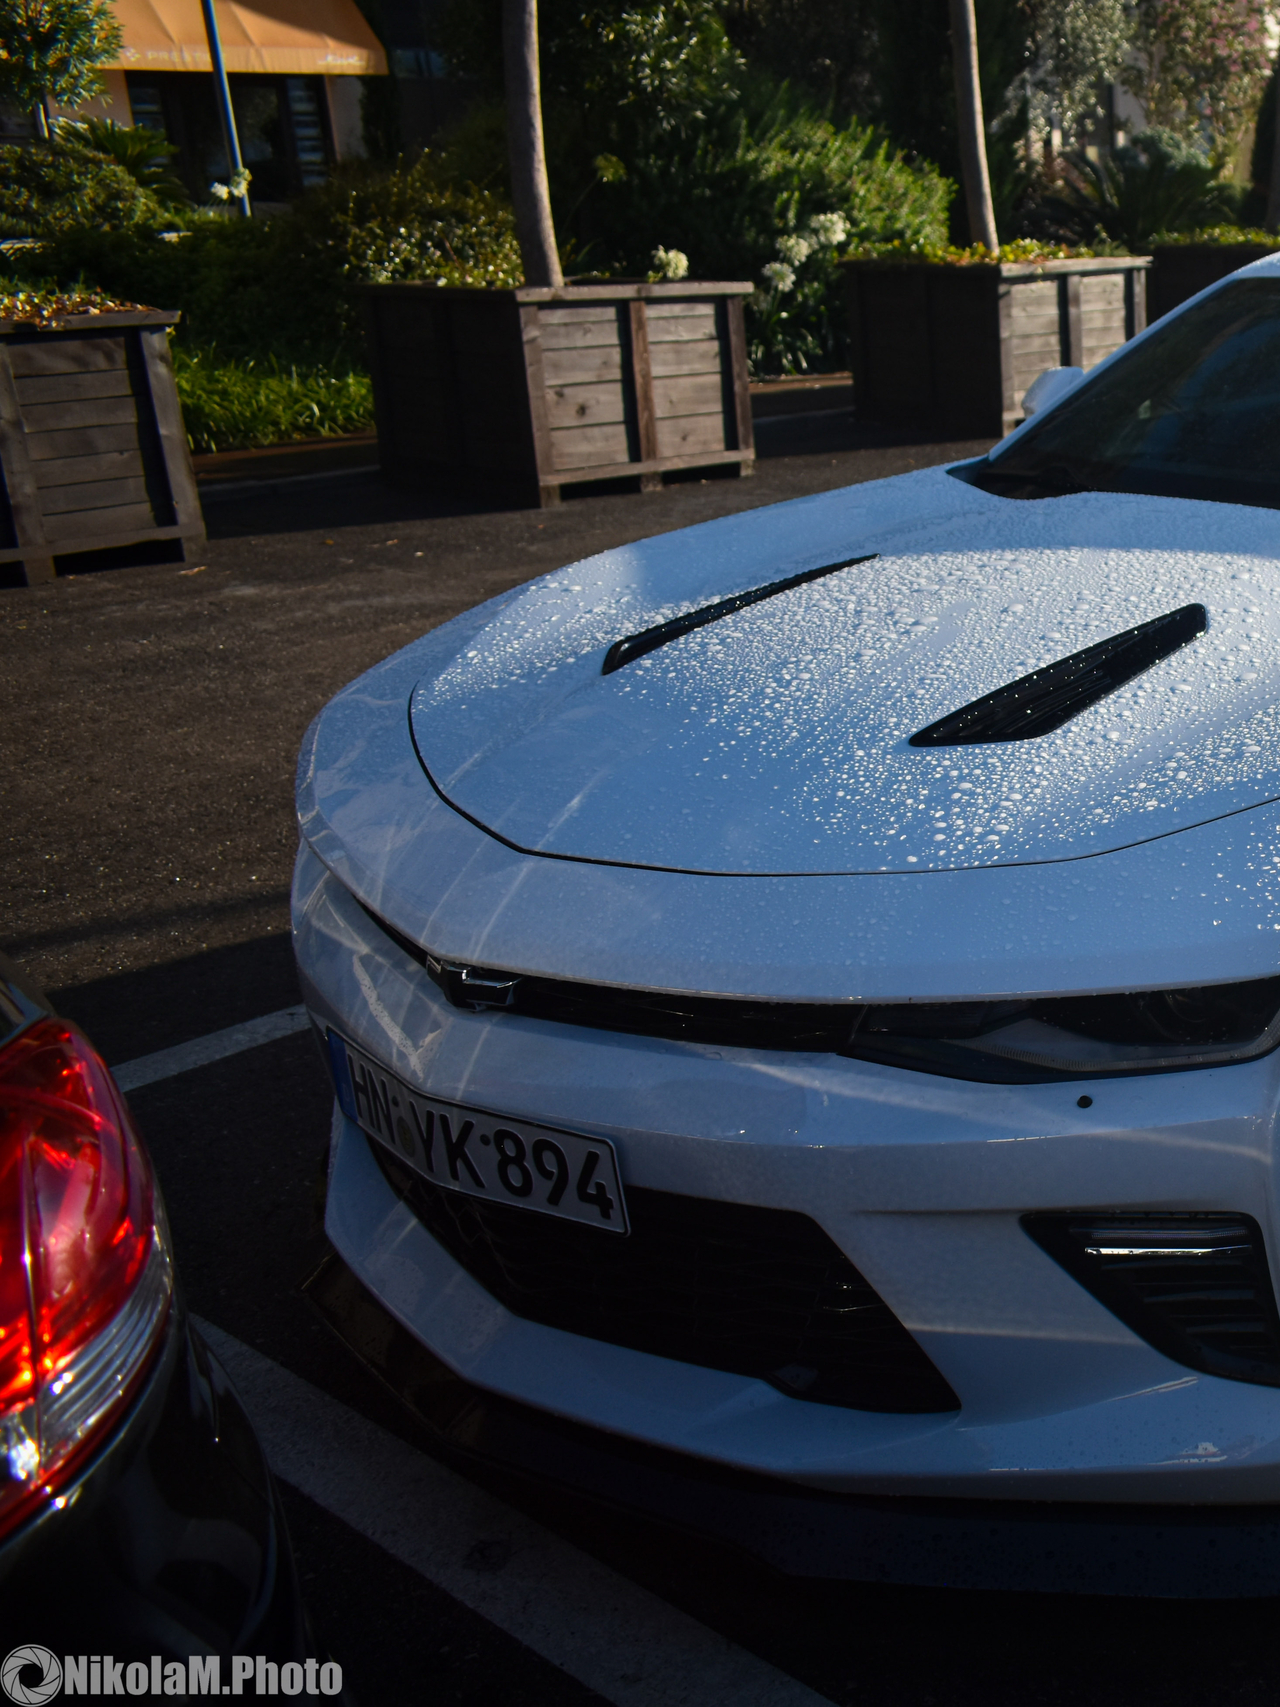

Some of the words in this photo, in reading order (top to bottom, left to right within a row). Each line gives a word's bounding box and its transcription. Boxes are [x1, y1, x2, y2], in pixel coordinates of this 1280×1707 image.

[348, 1053, 396, 1145] HN
[409, 1100, 486, 1189] YK
[493, 1128, 614, 1220] 894
